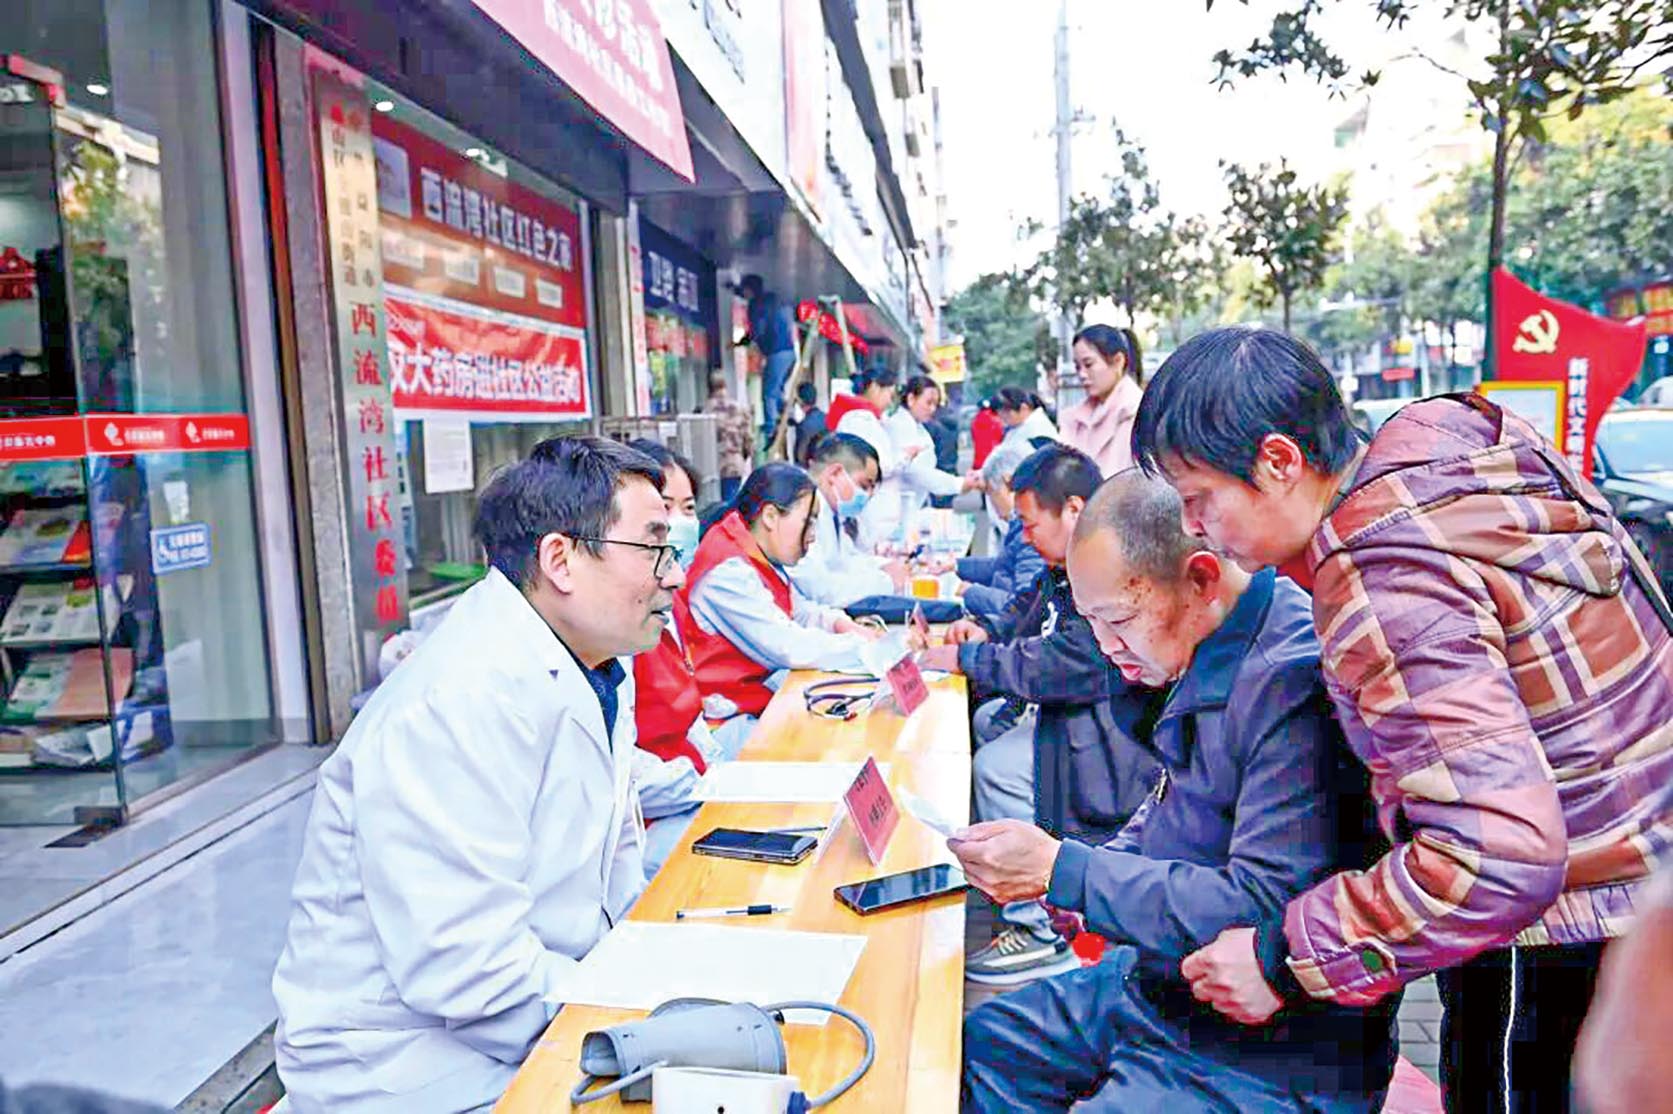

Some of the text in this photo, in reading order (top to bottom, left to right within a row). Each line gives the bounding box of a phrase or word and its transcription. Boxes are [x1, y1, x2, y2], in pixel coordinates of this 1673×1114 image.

[421, 166, 571, 271] 西流湾社区红色之家
